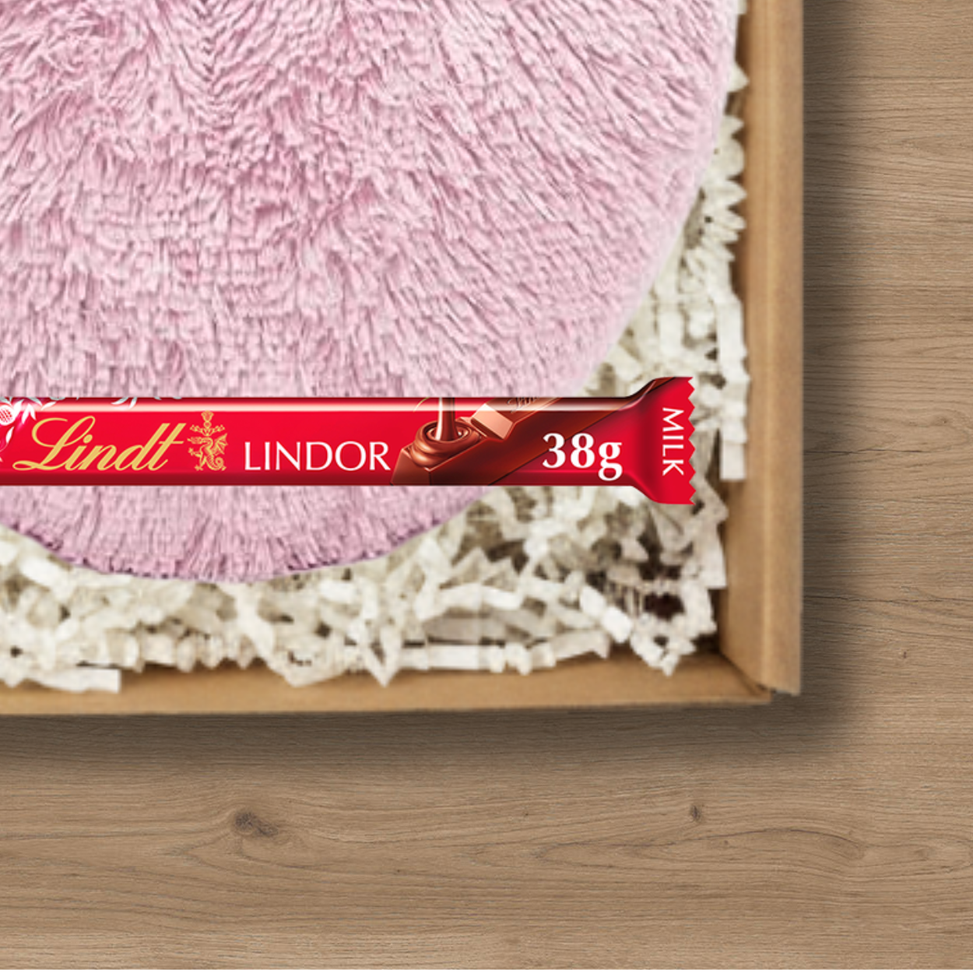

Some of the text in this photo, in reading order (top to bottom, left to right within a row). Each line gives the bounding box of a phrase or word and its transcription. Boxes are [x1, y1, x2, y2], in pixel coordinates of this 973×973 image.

[12, 415, 391, 472] Lindt LINDOR
[542, 432, 623, 482] 38g
[662, 407, 685, 476] MILK
